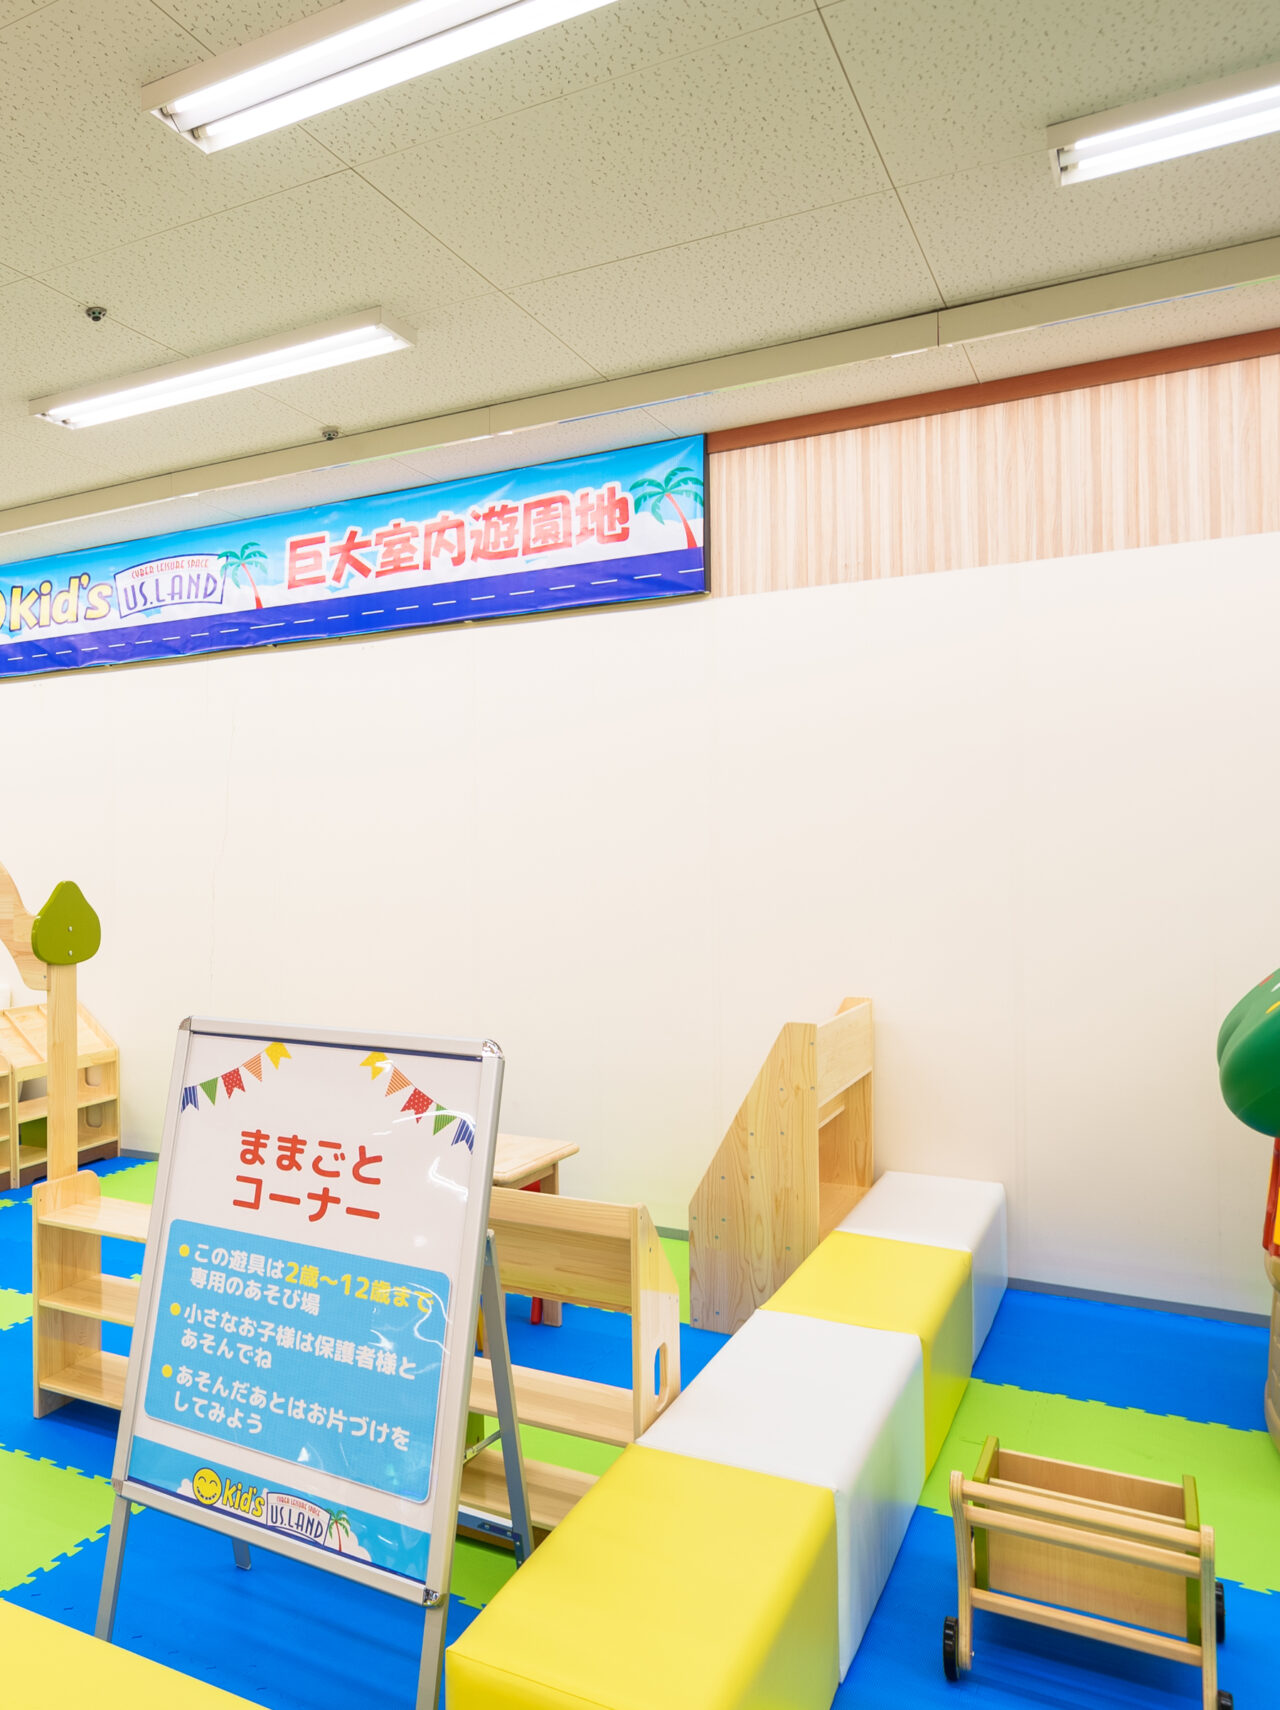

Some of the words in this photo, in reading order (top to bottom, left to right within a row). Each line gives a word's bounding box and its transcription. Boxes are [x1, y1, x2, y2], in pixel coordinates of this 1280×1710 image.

[287, 486, 630, 590] 巨大室内遊園地
[156, 560, 185, 573] LEISURE
[187, 559, 208, 569] SPACE
[240, 1129, 383, 1185] ままごと
[233, 1175, 380, 1222] コーナー
[190, 1267, 320, 1316] 専用のあそび場
[181, 1328, 272, 1369] あそんでね
[183, 1303, 416, 1380] 小さなお子様は保護者様と
[174, 1391, 263, 1434] してみよう
[176, 1365, 410, 1451] あそんだあとはお片づけを
